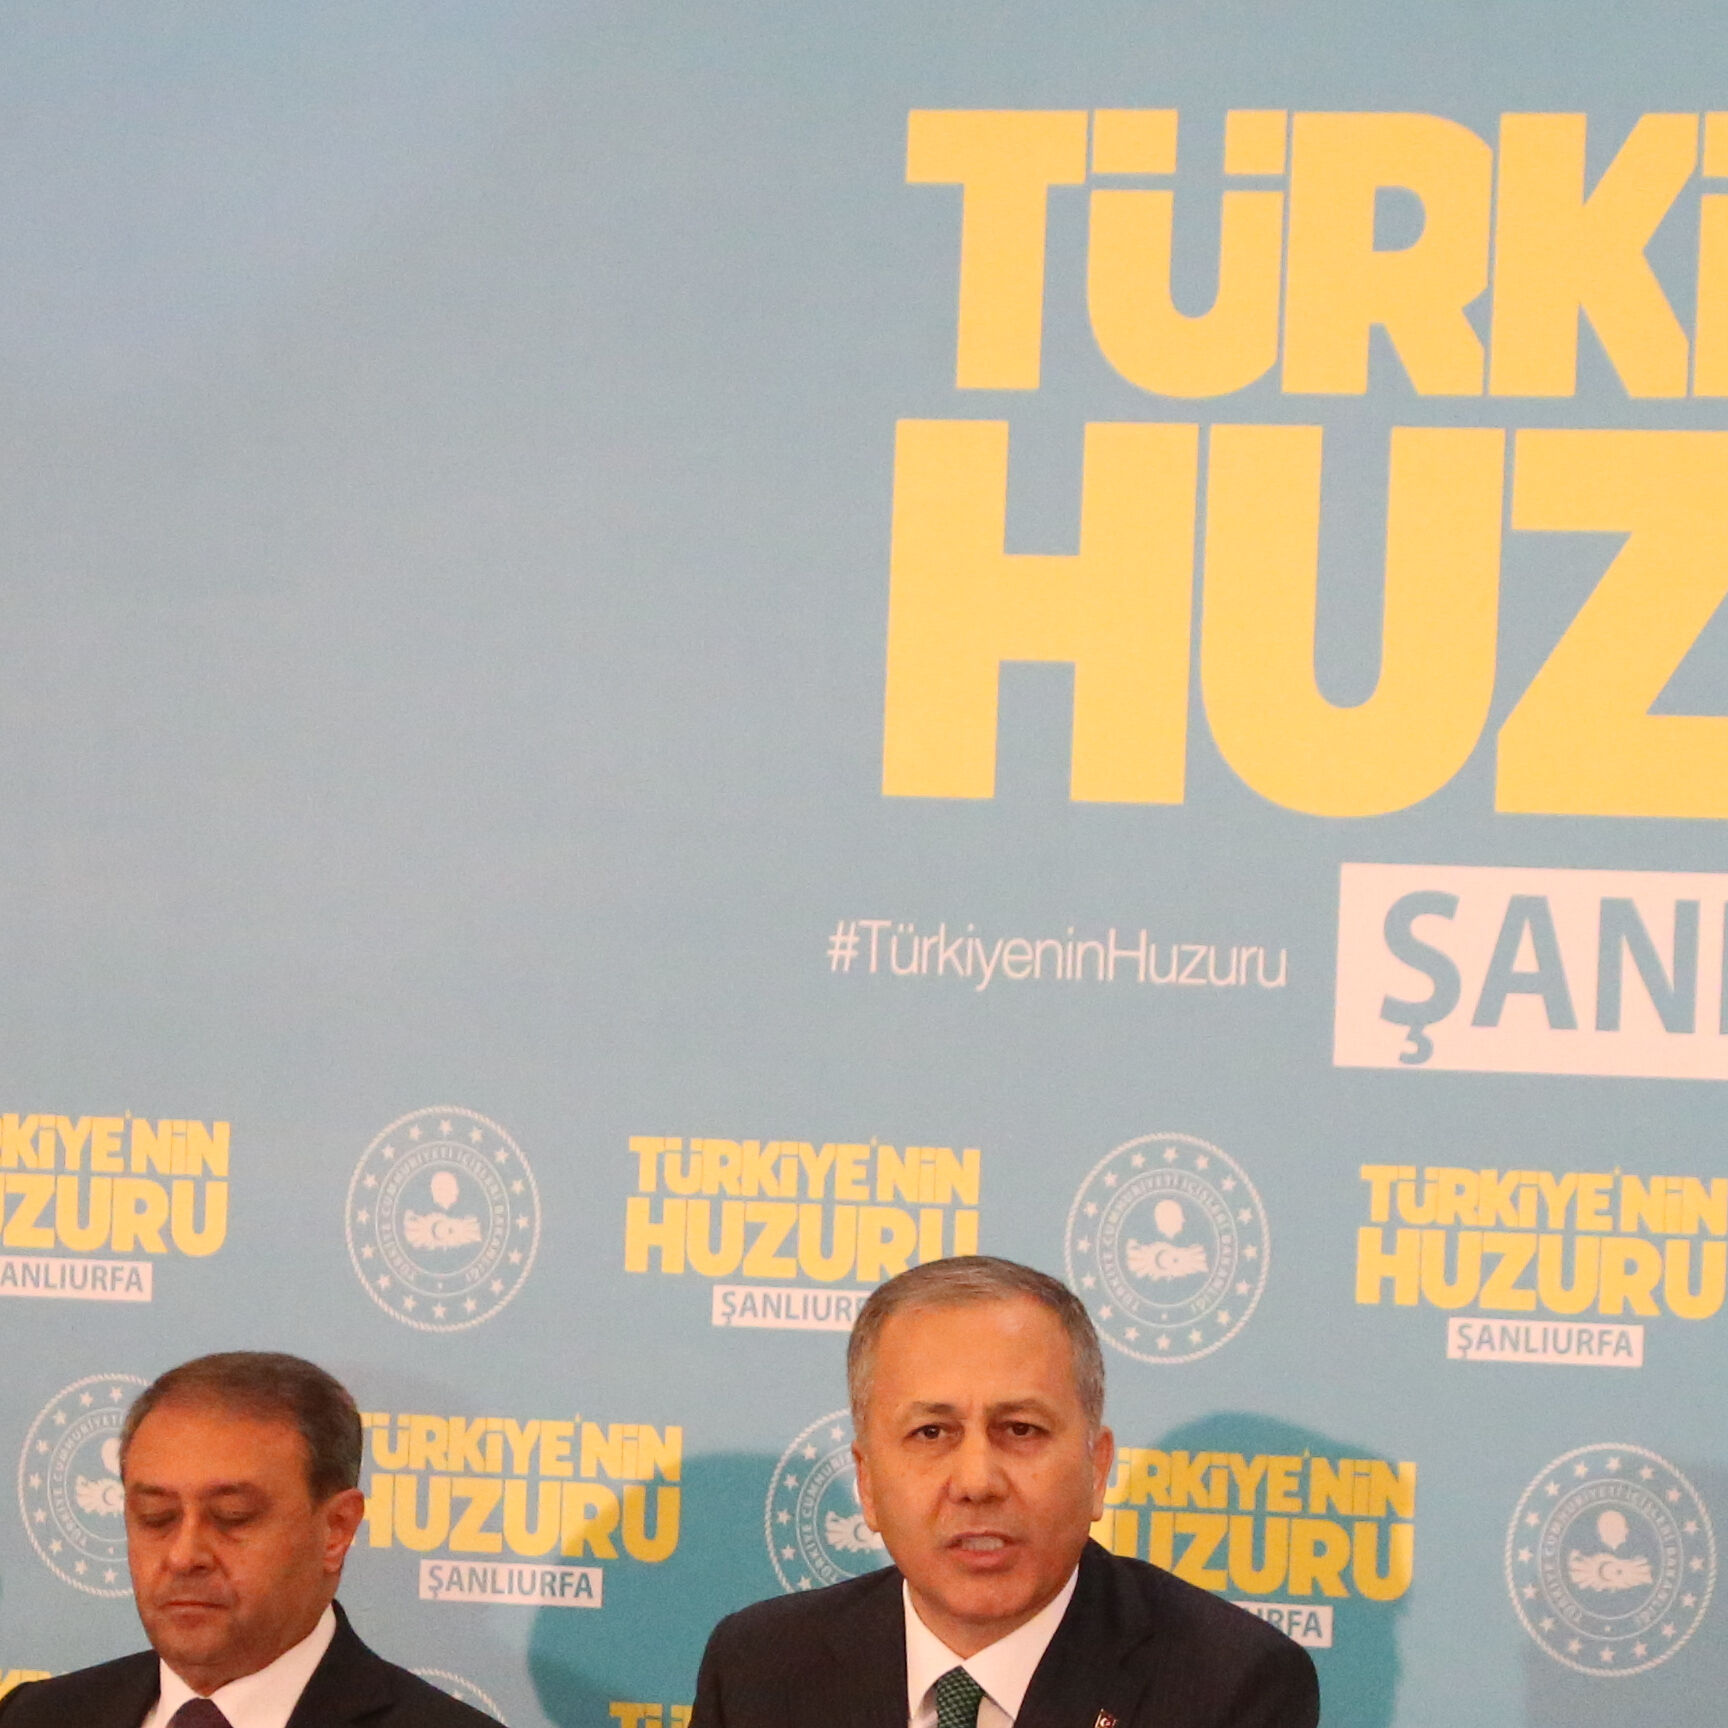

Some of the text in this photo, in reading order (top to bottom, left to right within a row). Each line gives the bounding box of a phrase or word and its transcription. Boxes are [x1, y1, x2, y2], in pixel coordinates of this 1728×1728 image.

[829, 920, 1288, 991] #TürkiyeninHuzuru
[623, 1197, 978, 1282] HUZURU
[1354, 1227, 1726, 1318] HUZURU
[722, 1291, 866, 1325] ŞANLIUR
[1457, 1322, 1633, 1357] ŞANLIURFA
[429, 1565, 593, 1598] ŞANLIURFA
